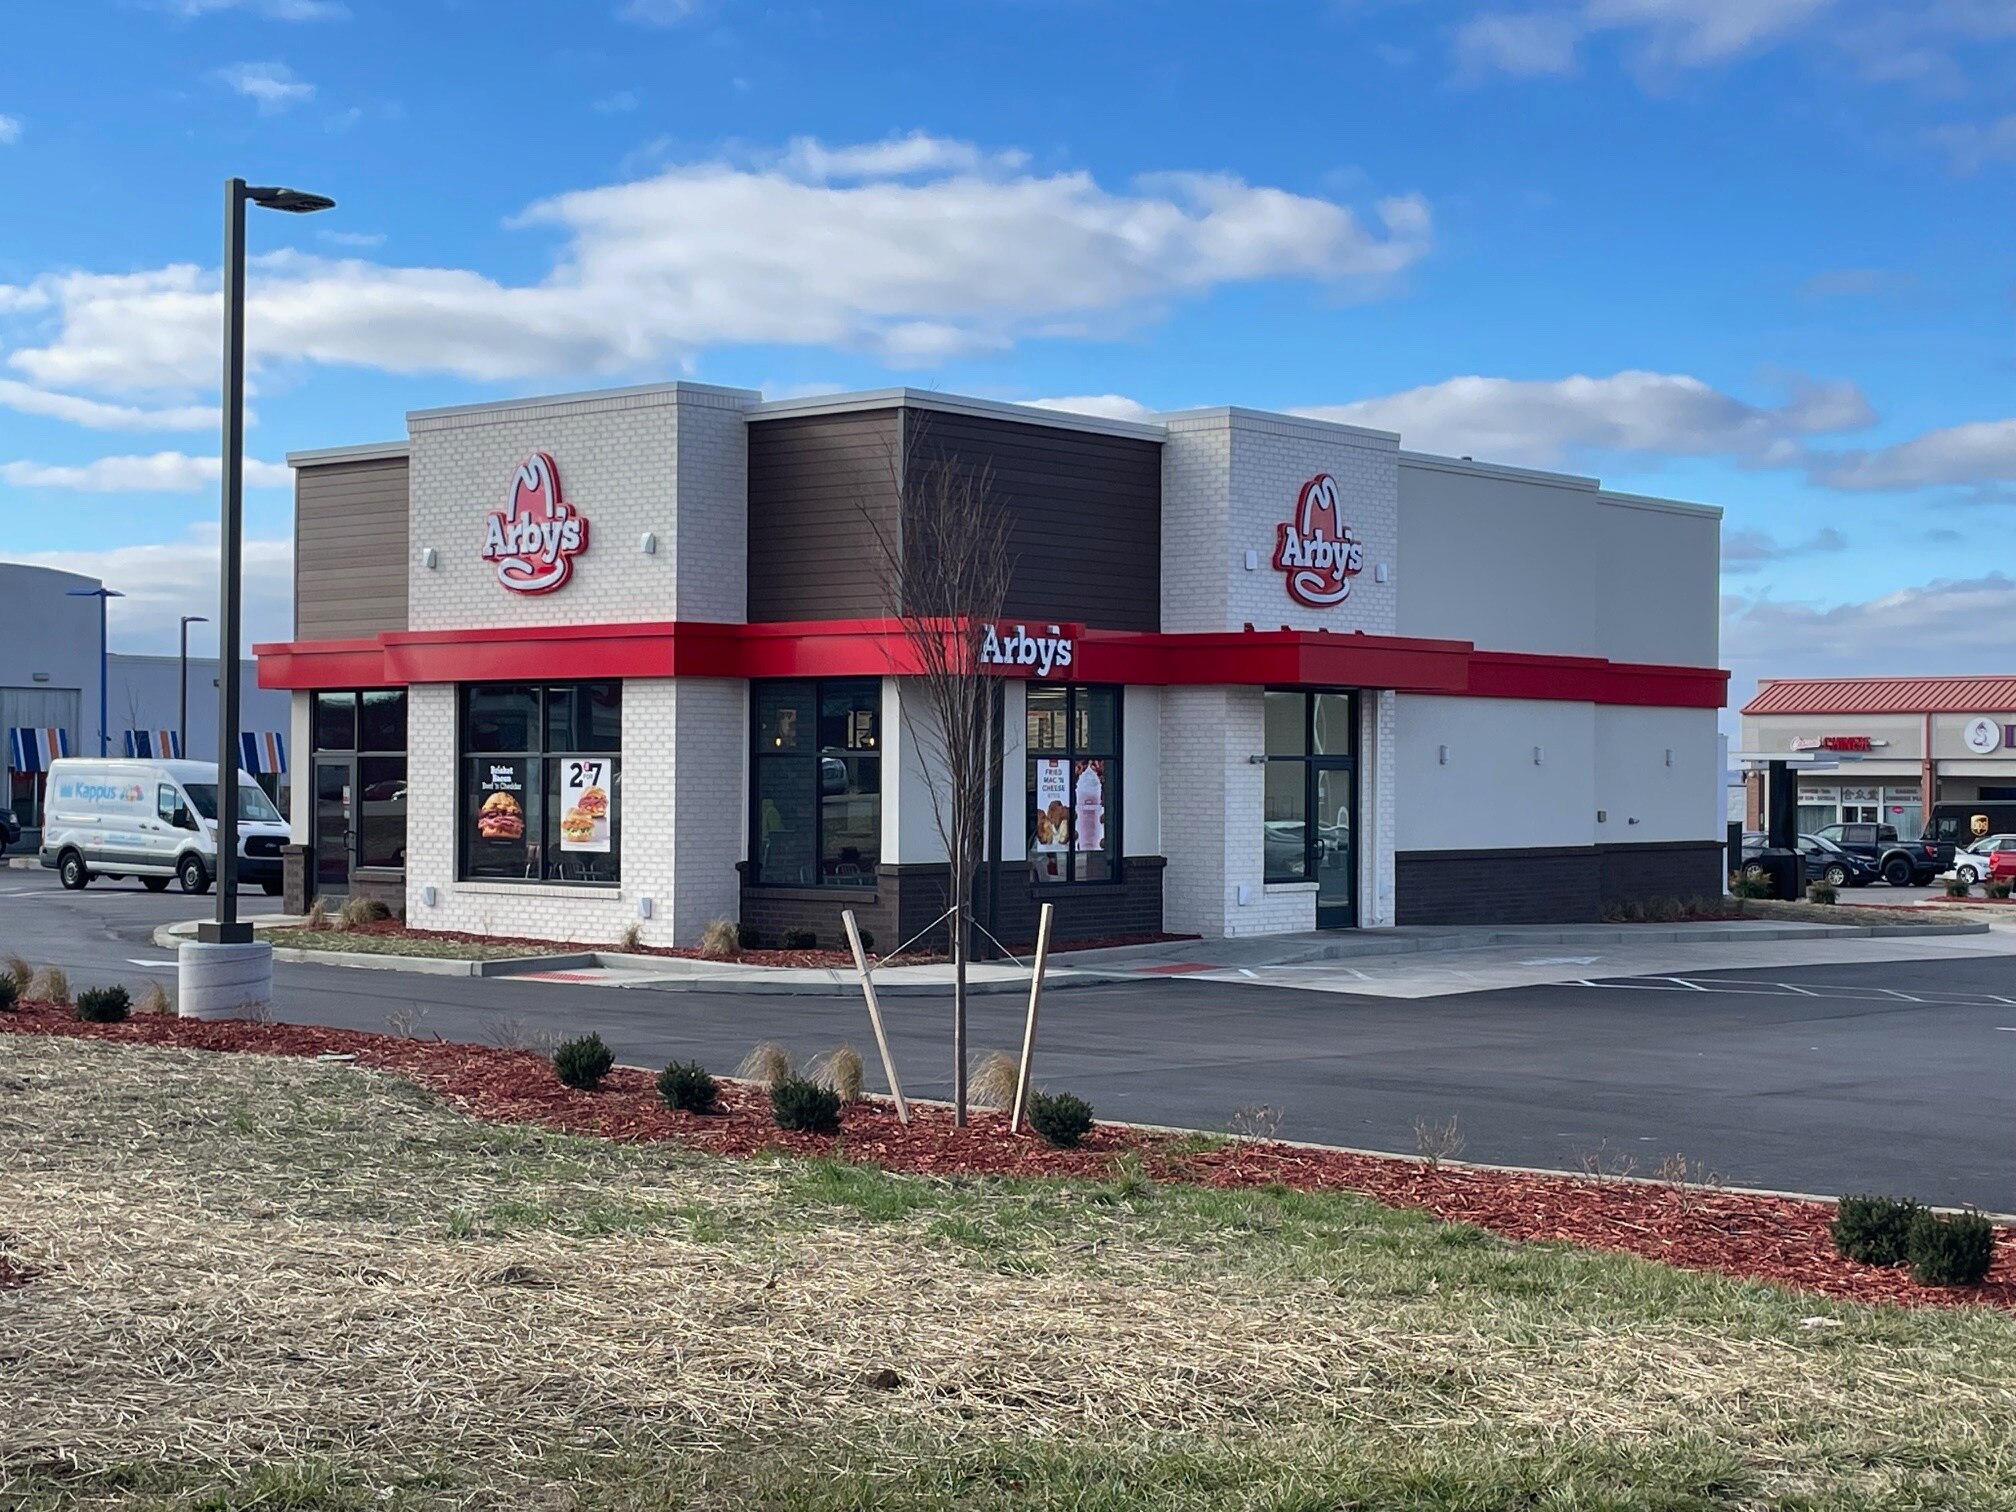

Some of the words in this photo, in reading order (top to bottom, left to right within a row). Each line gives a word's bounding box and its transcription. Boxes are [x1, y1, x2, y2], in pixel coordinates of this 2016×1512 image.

[482, 506, 581, 563] Arby's
[1281, 526, 1362, 580] Arby's
[980, 623, 1072, 677] Arby's
[570, 762, 583, 788] 2
[1041, 784, 1065, 792] CHEESE
[1043, 776, 1057, 784] MAC
[75, 782, 116, 802] Kappus
